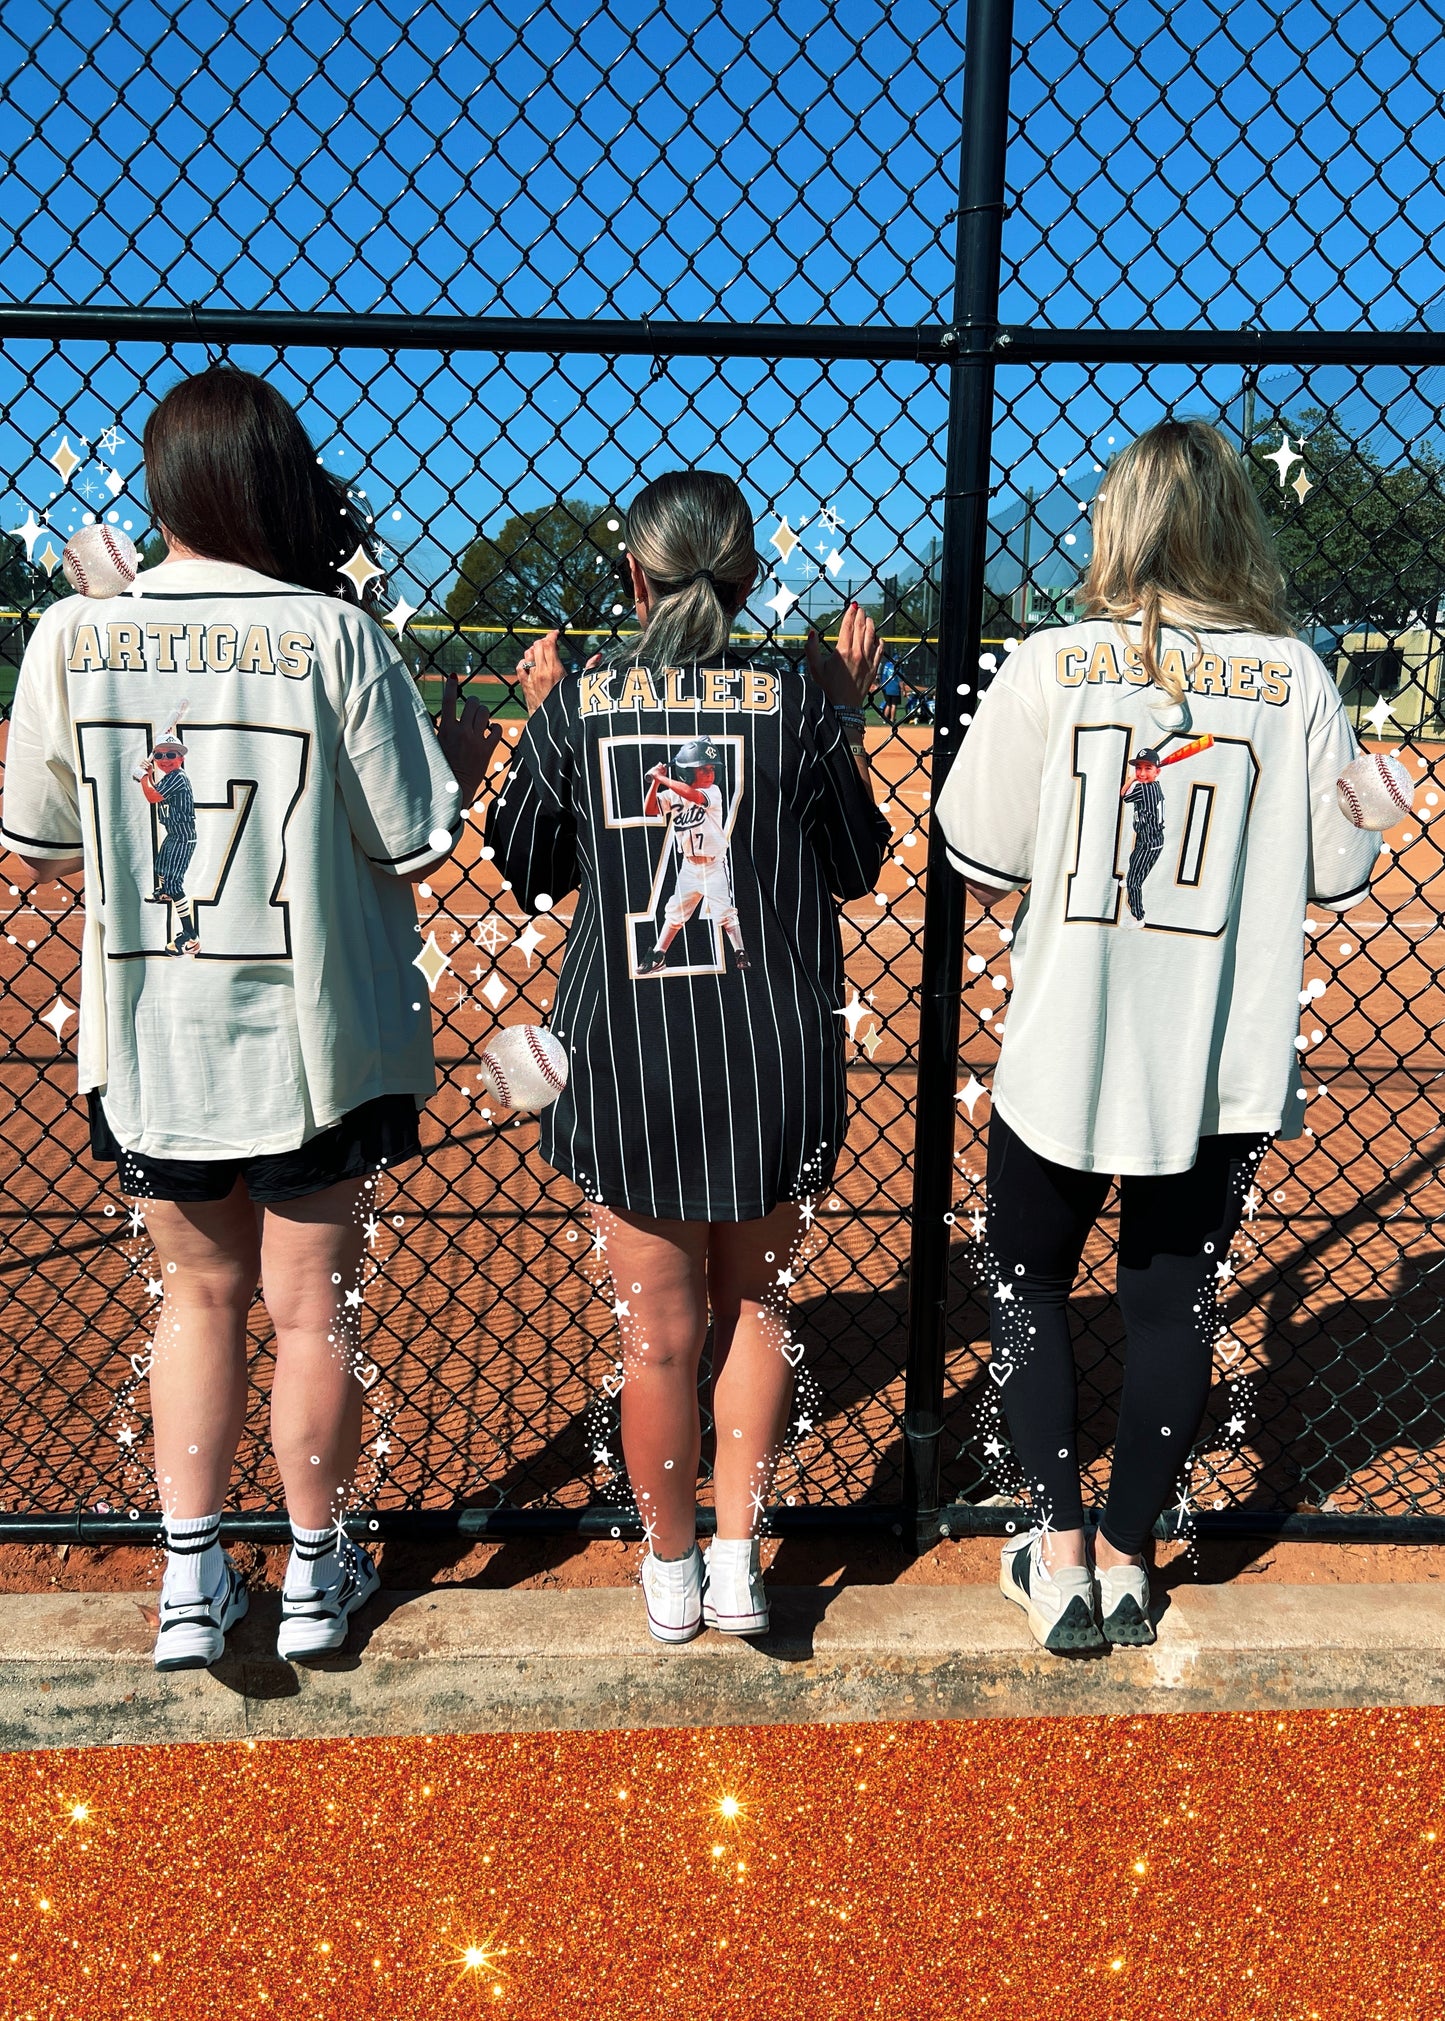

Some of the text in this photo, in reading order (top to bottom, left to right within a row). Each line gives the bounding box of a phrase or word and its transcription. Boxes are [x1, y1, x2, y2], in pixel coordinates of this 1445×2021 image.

[67, 622, 314, 680] ARTIGAS
[1056, 641, 1292, 707] CASARES
[578, 667, 780, 717] KALEB
[74, 719, 311, 963] 17
[598, 734, 744, 980] 7
[696, 833, 704, 850] 7
[1064, 723, 1262, 941] 10
